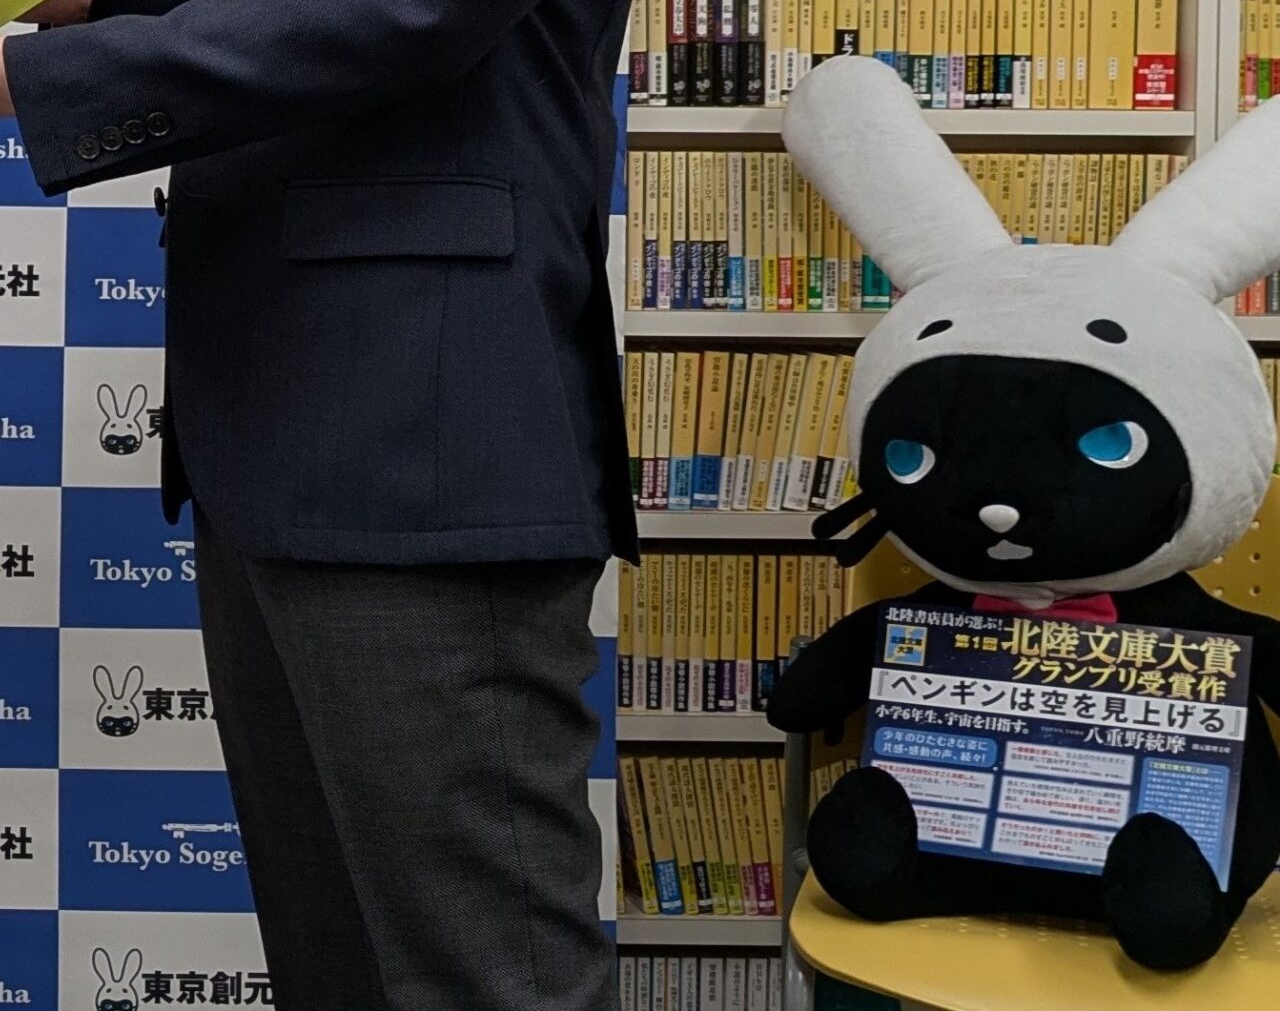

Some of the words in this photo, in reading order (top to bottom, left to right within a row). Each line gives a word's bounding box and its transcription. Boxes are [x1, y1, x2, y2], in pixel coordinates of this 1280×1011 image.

[90, 559, 172, 587] Tokyo
[1001, 618, 1241, 679] 北陸文庫大賞
[1011, 658, 1227, 703] グランプリ受賞作
[1084, 729, 1187, 755] 八重野統摩
[89, 842, 170, 870] Tokyo
[180, 843, 246, 871] Soge
[142, 971, 274, 1005] 東京創元
